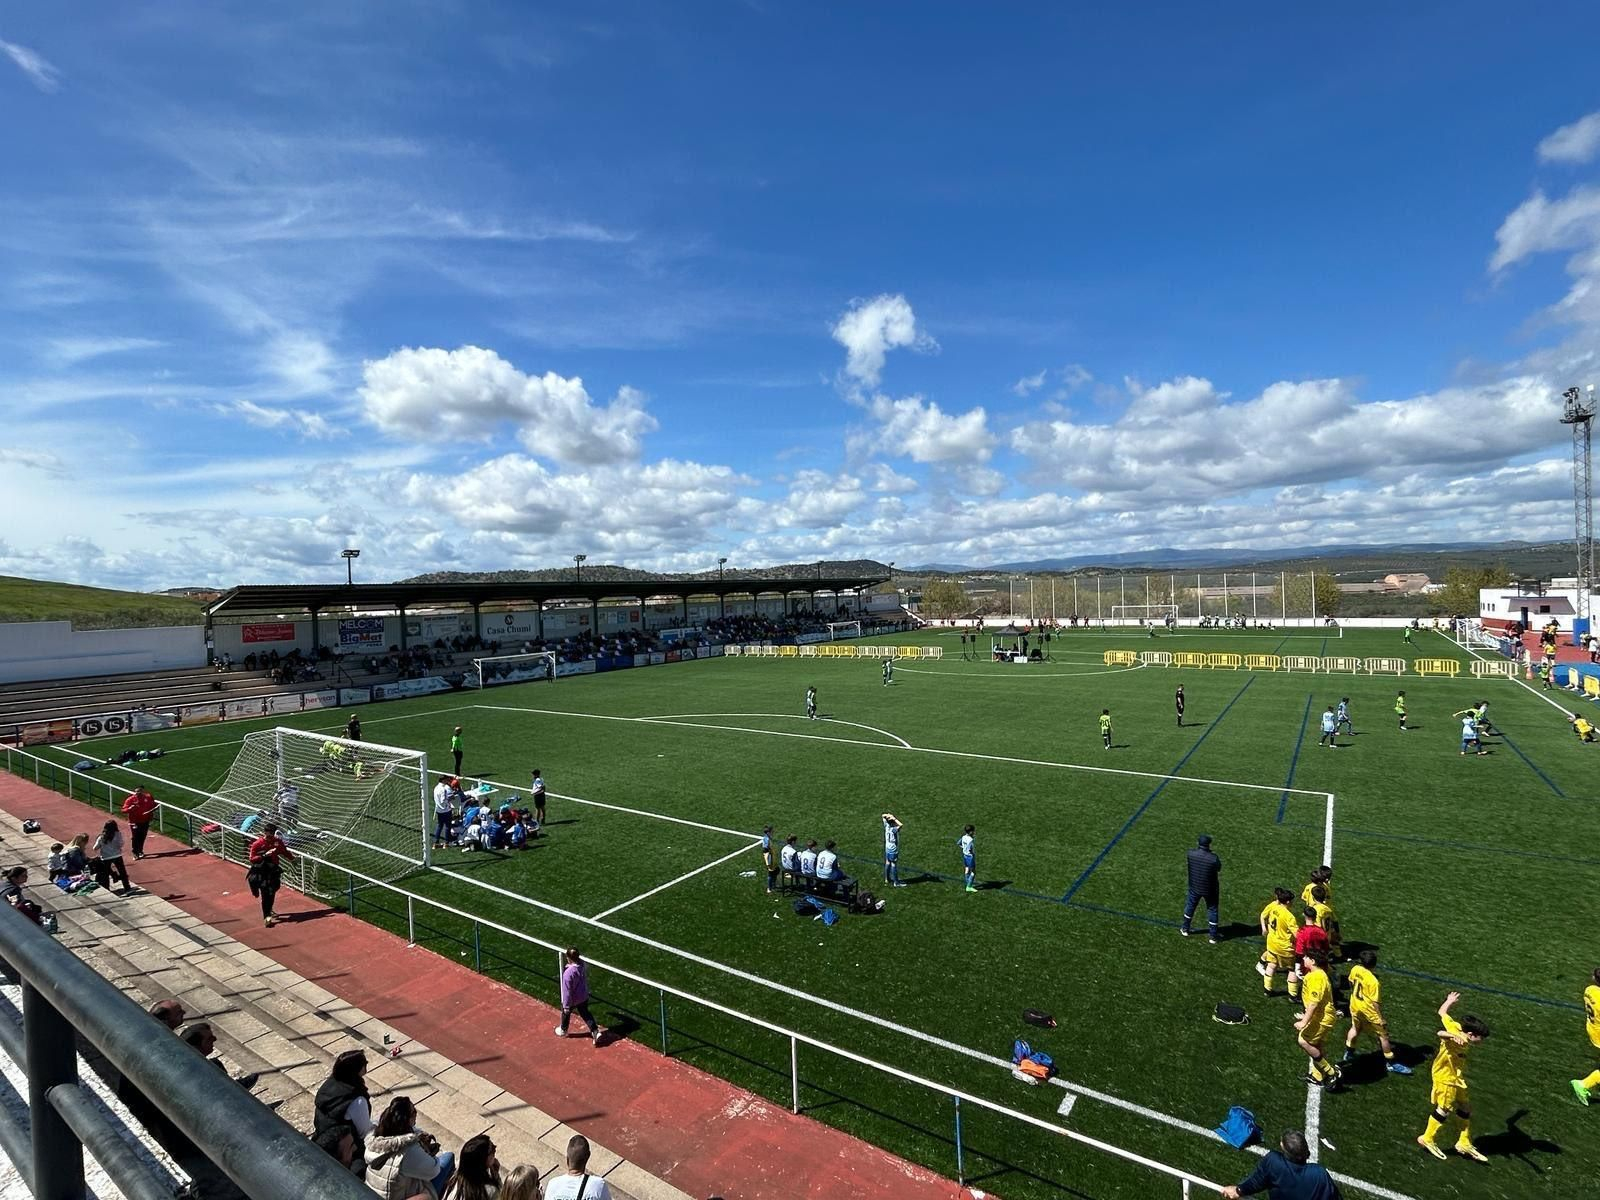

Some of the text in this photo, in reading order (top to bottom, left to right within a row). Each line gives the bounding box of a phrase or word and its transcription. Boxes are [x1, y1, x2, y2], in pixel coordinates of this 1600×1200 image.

[487, 624, 532, 635] Casa Chumi
[340, 633, 383, 644] BigMat
[803, 857, 809, 870] 8
[819, 856, 826, 869] 9
